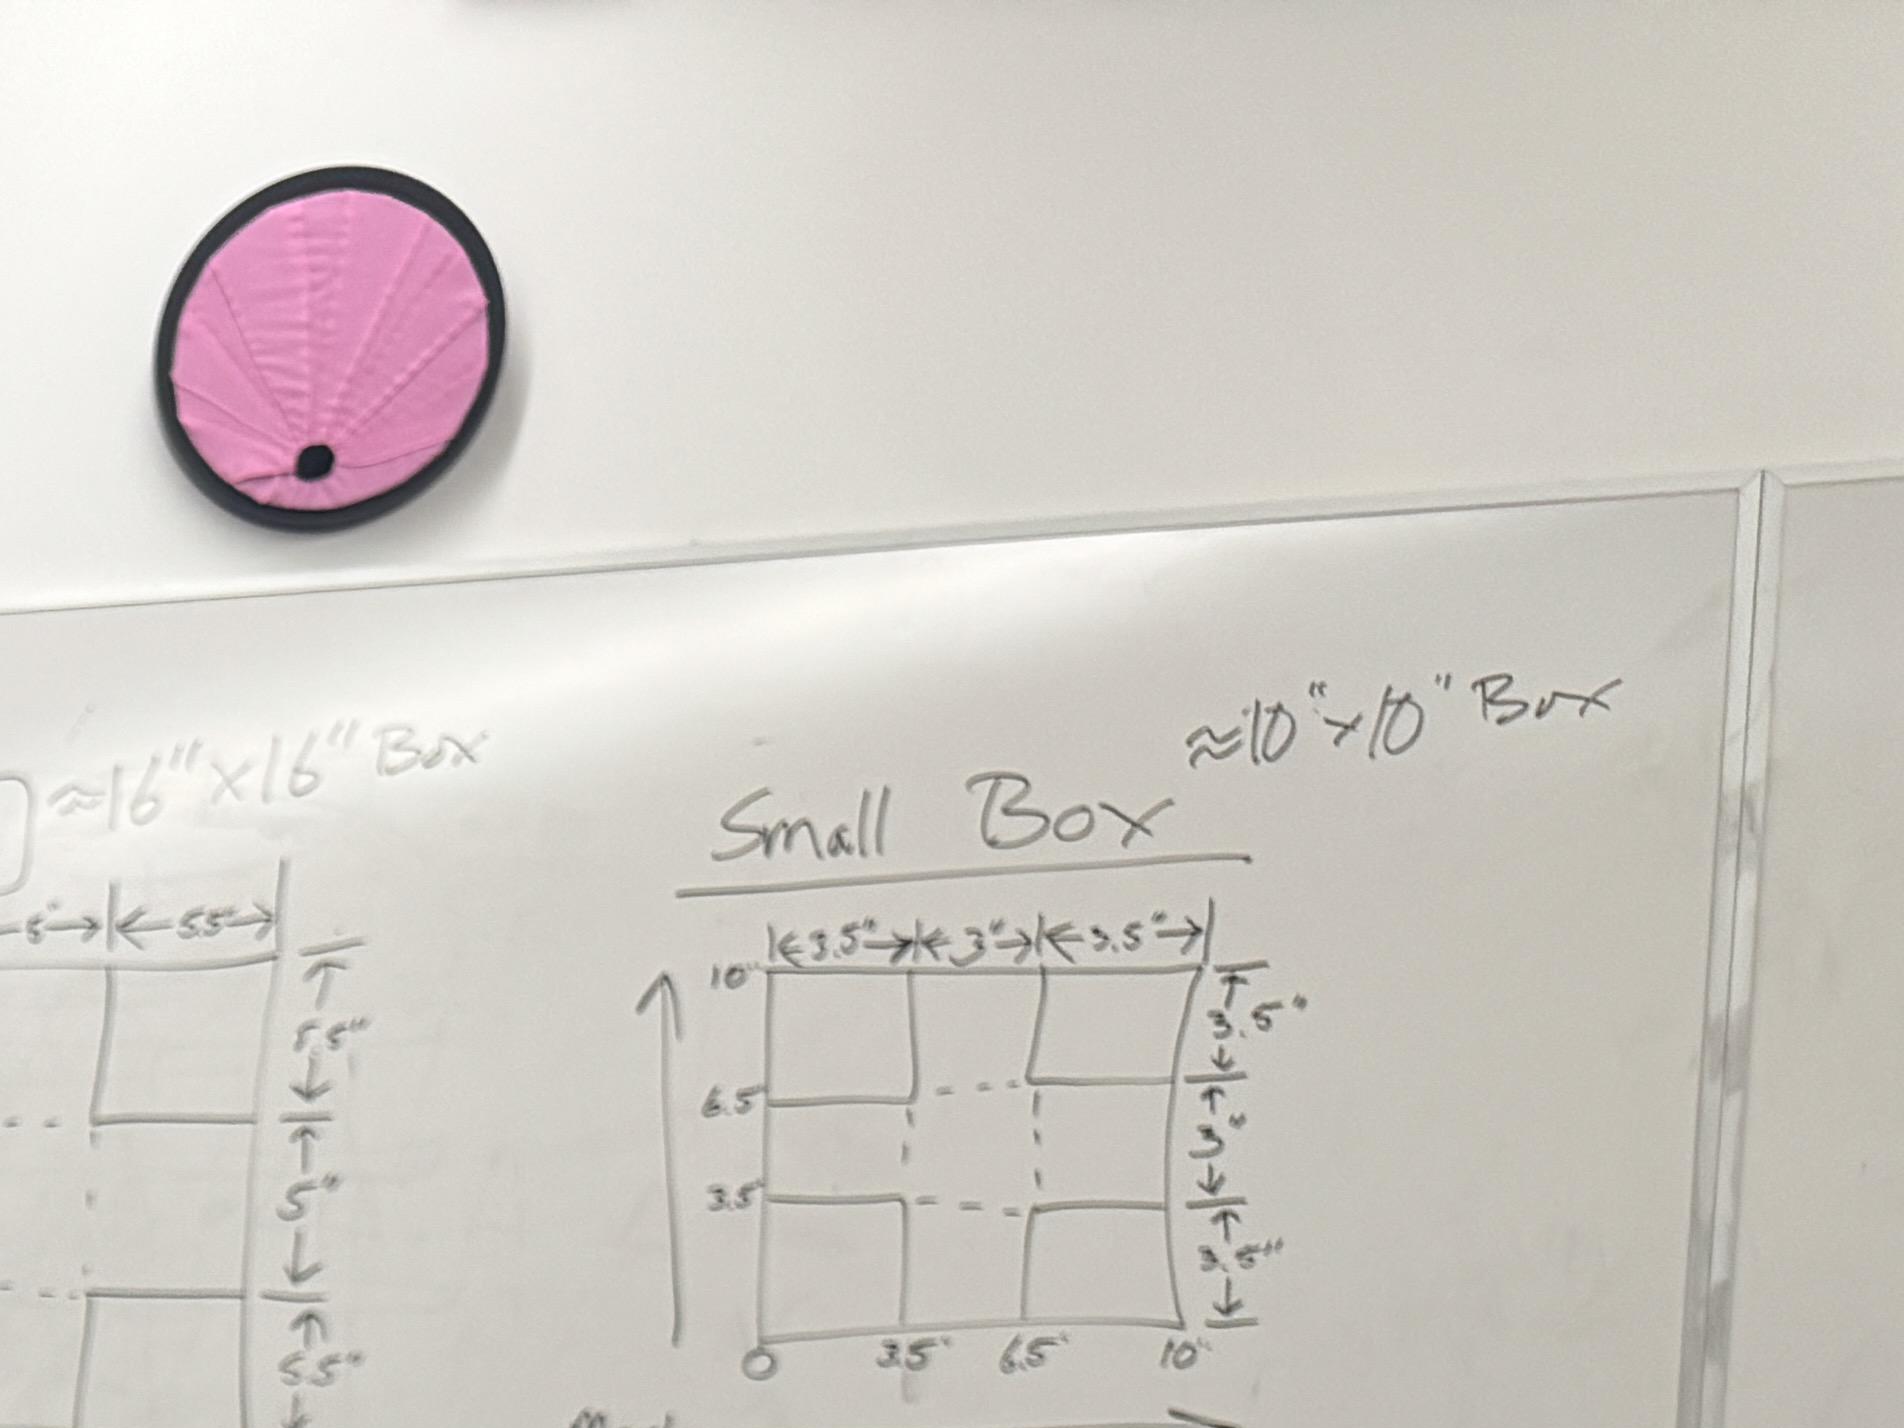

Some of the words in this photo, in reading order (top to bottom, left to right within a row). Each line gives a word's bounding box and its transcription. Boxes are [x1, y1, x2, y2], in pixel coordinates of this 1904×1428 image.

[1470, 674, 1623, 724] Box
[373, 724, 490, 776] Box
[711, 786, 891, 863] Small
[966, 771, 1175, 852] Box
